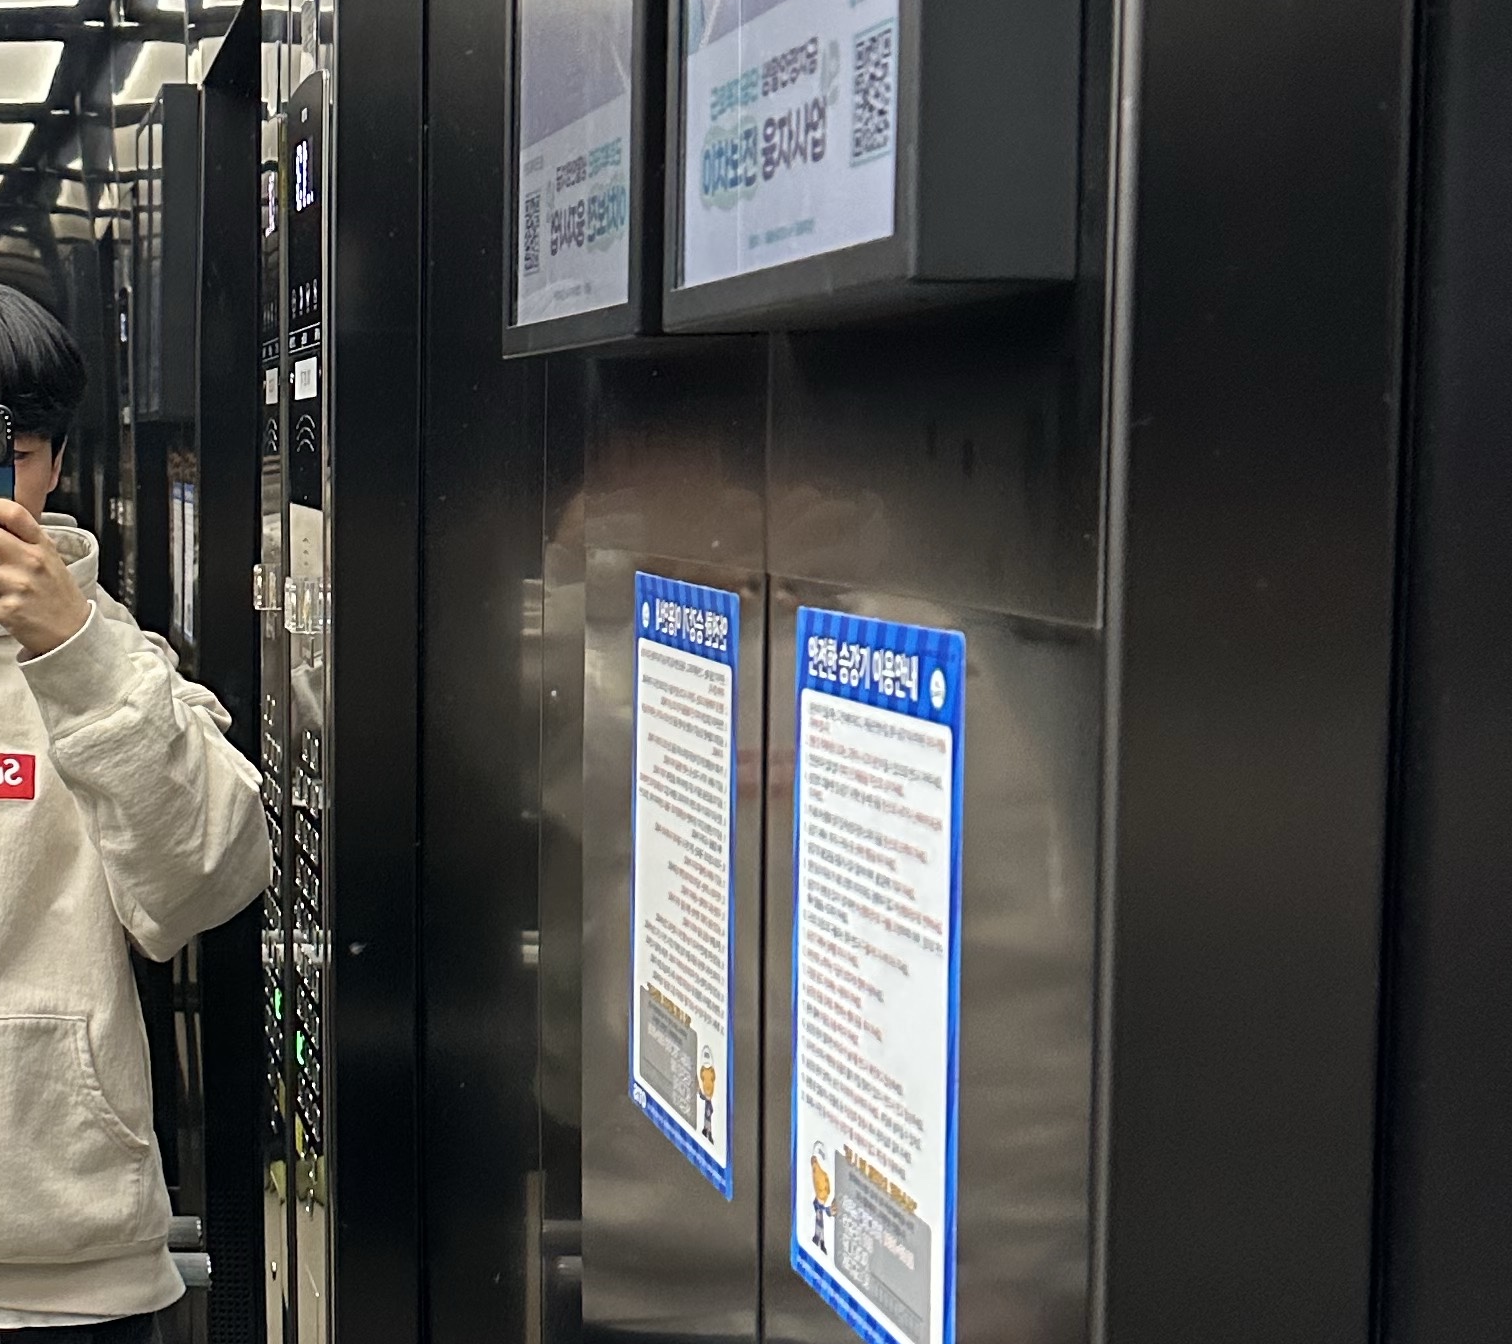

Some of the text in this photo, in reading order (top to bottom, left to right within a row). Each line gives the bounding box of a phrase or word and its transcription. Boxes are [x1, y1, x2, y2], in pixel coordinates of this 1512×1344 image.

[761, 96, 828, 181] 융자사업
[808, 636, 919, 702] 안전한 승강기 이용안내
